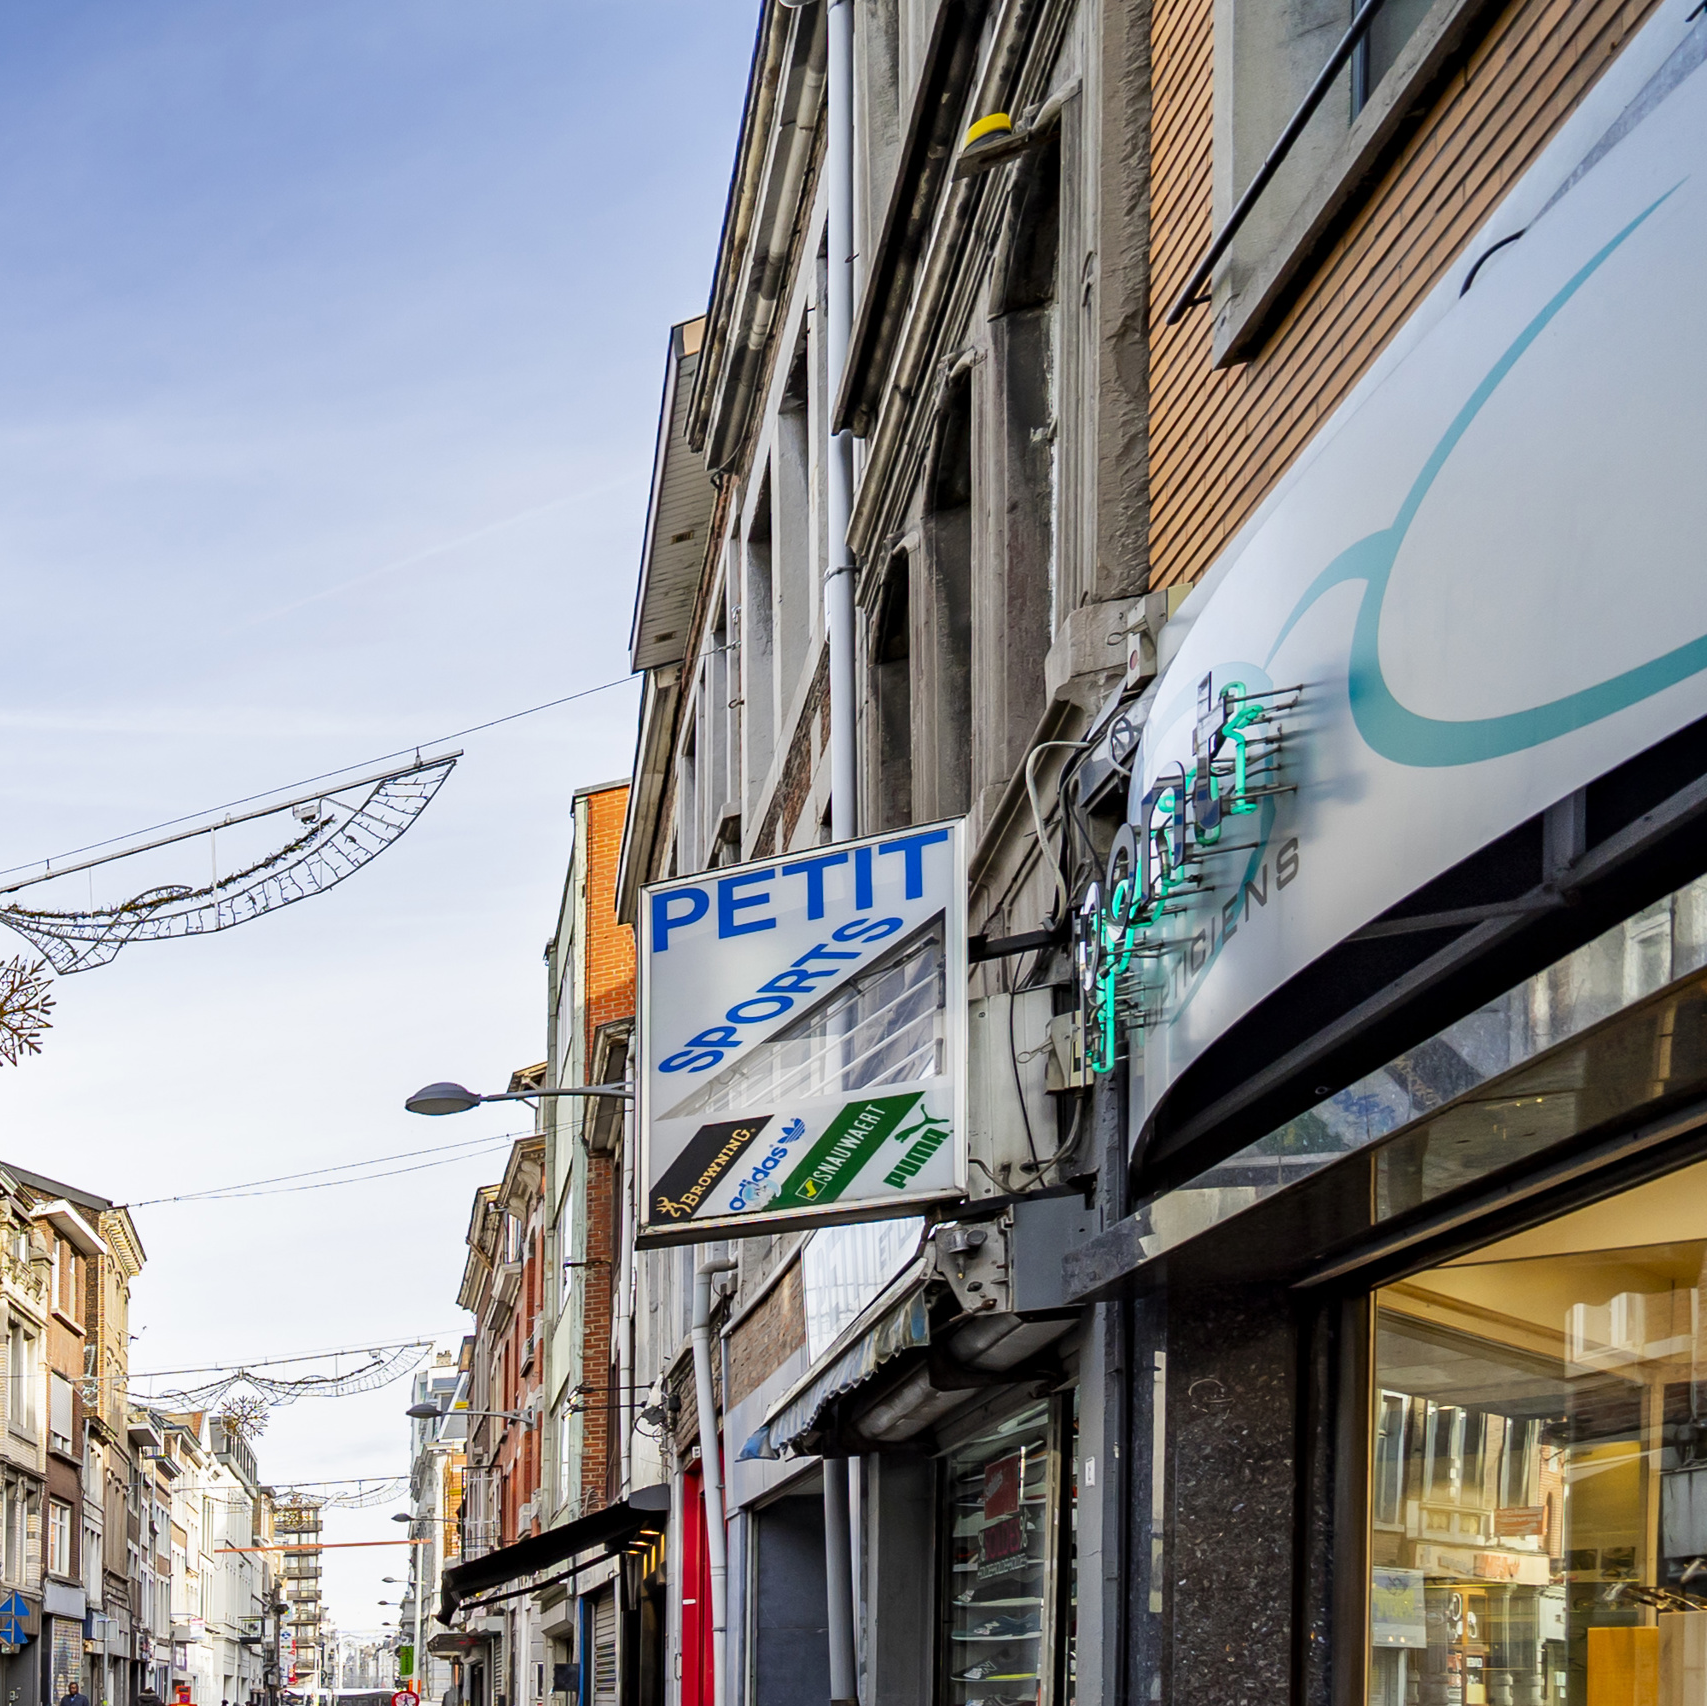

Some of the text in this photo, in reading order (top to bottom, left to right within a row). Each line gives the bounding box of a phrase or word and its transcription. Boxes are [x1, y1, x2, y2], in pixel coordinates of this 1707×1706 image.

[652, 830, 948, 953] PETIT
[658, 917, 903, 1073] SPORTS
[812, 1104, 886, 1182] SNAUWAERT
[883, 1128, 950, 1189] PUMA
